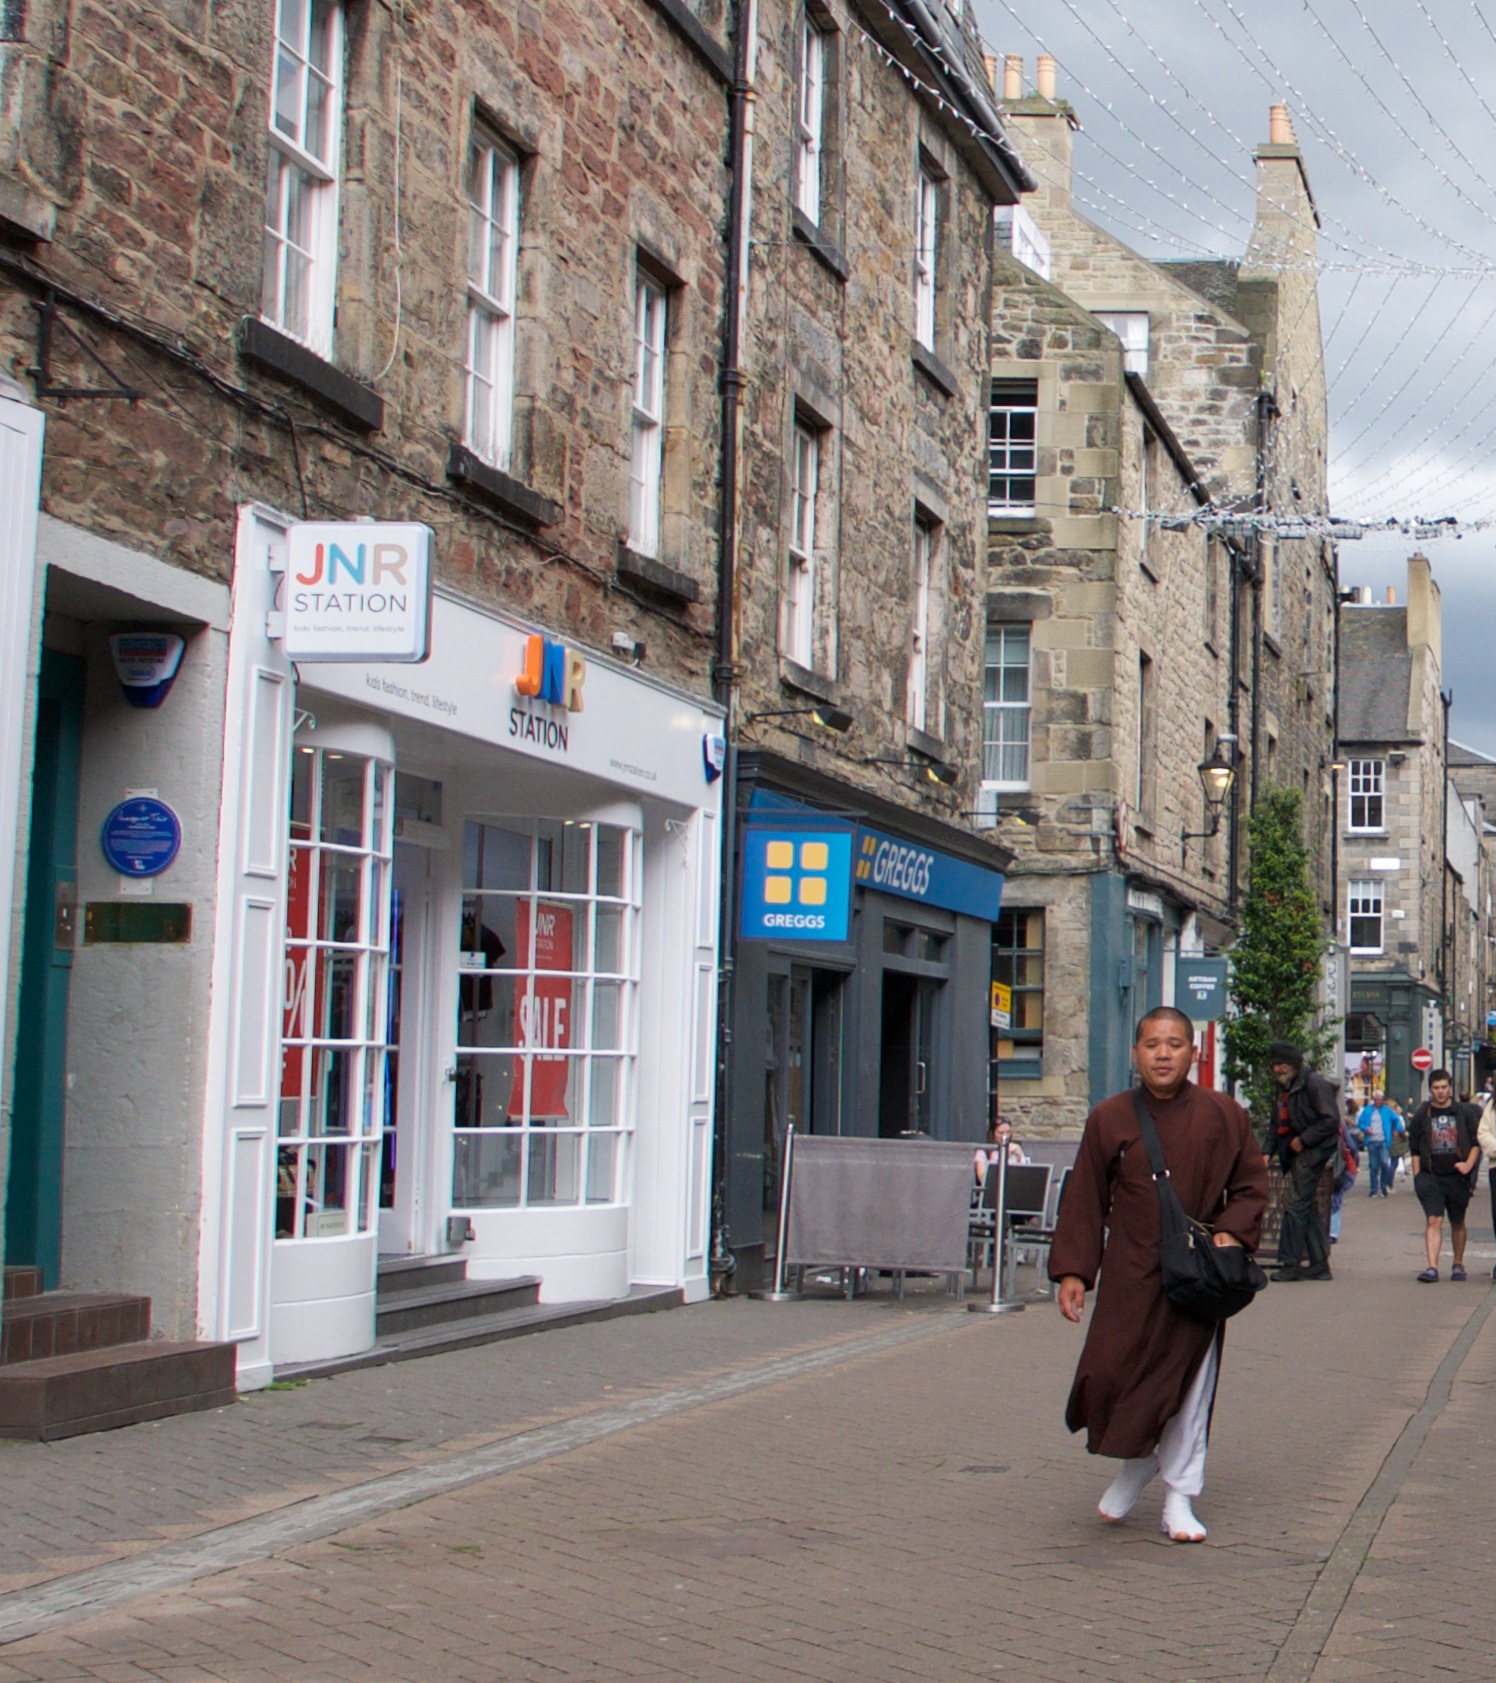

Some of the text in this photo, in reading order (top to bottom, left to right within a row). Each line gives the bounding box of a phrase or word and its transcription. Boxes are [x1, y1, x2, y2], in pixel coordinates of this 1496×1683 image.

[296, 543, 408, 585] JNR
[294, 593, 407, 613] STATION
[516, 634, 586, 713] JNR
[509, 708, 569, 751] STATION
[873, 841, 934, 895] GREGGS
[763, 913, 826, 929] GREGGS
[518, 995, 567, 1061] SALE
